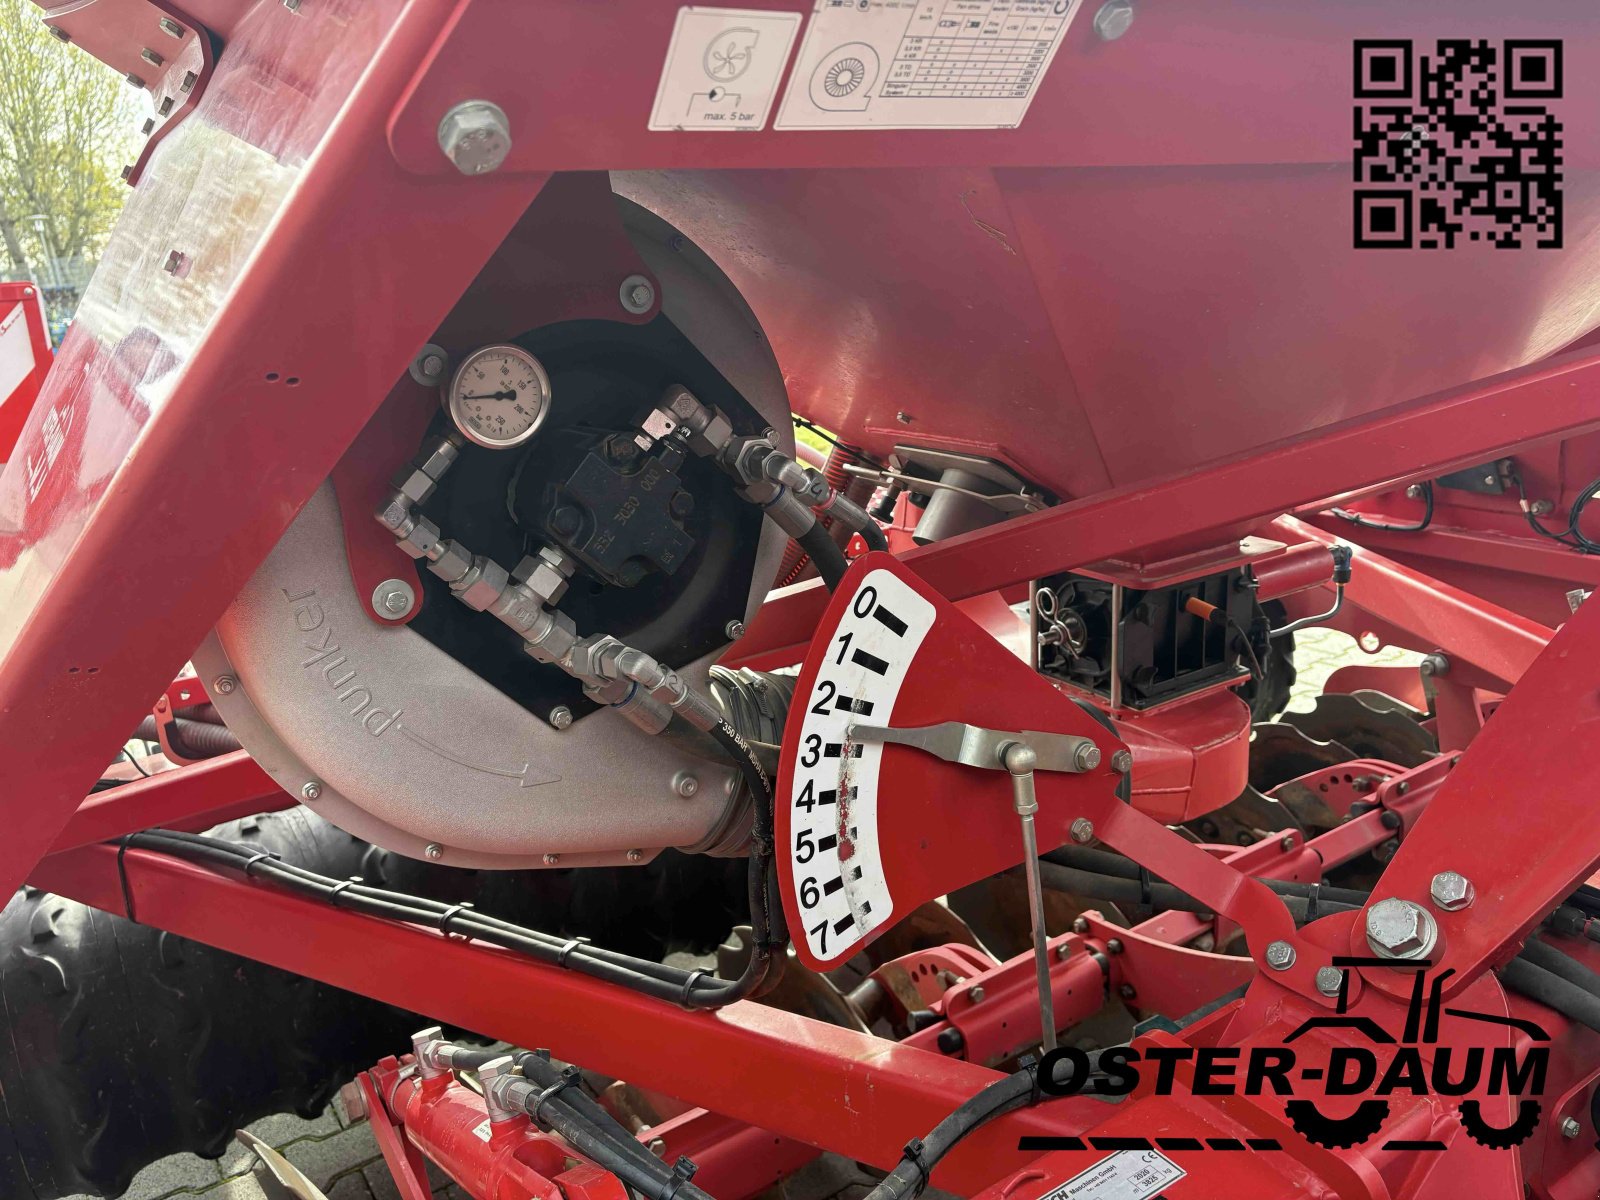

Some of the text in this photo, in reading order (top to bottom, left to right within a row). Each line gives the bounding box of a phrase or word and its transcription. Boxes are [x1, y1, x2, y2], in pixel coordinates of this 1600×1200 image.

[730, 112, 737, 120] 5
[736, 112, 755, 120] bar
[476, 371, 485, 380] 50
[500, 364, 510, 376] 100
[518, 380, 527, 390] 150
[495, 415, 506, 426] 250
[514, 404, 524, 414] 200
[853, 586, 878, 619] 0
[281, 588, 404, 738] punker
[836, 632, 854, 666] 1
[811, 681, 836, 716] 2
[722, 722, 736, 738] 350
[734, 733, 748, 752] BAR
[800, 734, 822, 769] 3
[795, 779, 816, 814] 4
[795, 828, 815, 864] 5
[799, 876, 820, 910] 6
[809, 920, 829, 955] 7
[1069, 1176, 1100, 1194] Maschinen
[1098, 1164, 1117, 1178] GmbH
[1141, 1175, 1159, 1188] 3825
